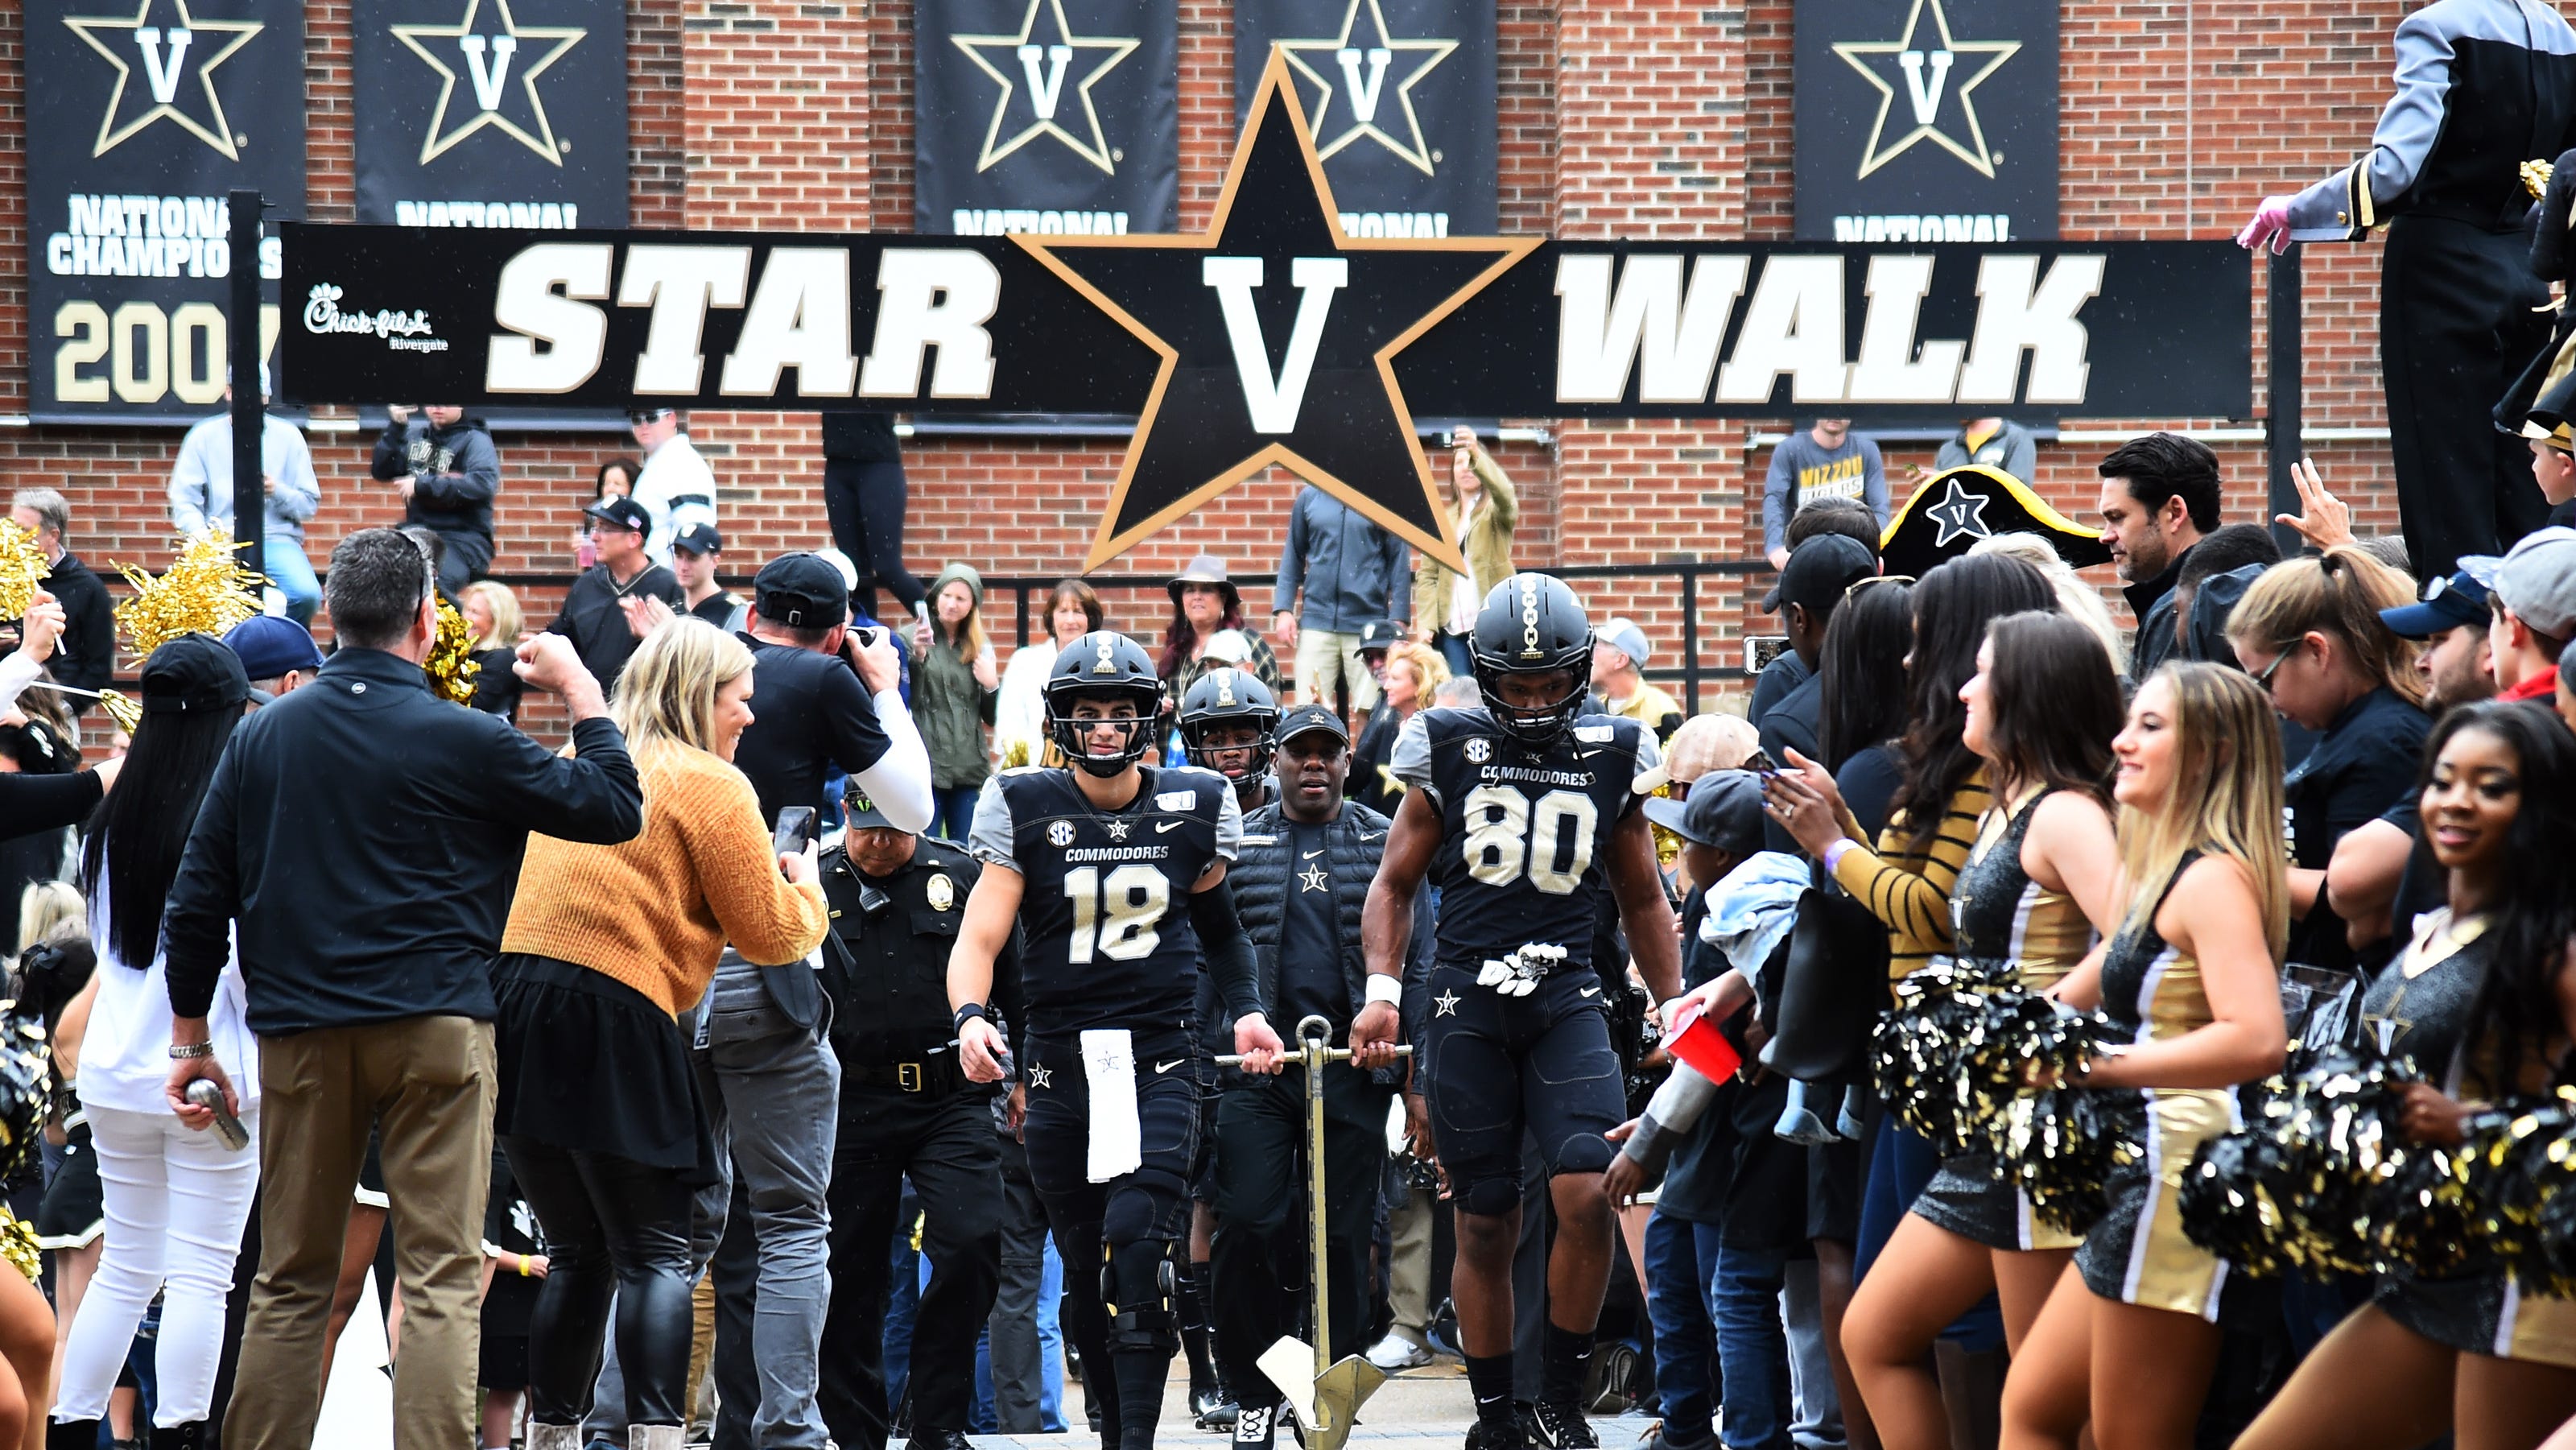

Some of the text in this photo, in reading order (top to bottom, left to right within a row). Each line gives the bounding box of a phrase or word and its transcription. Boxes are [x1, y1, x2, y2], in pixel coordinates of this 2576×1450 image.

[134, 27, 192, 103] V
[460, 35, 517, 110] V
[1017, 45, 1073, 119] V
[1337, 48, 1393, 122] V
[1899, 51, 1954, 124] V
[68, 194, 231, 238] NATIONA
[1338, 213, 1449, 238] IONA
[47, 233, 283, 279] CHAMPIOS
[389, 337, 448, 353] Rivergate
[485, 243, 2107, 433] STAR V WALK
[1800, 454, 1864, 488] MIZZOU
[1949, 503, 1967, 526] V
[1465, 739, 1491, 762] SEC
[1480, 765, 1587, 787] COMMODORES
[1048, 820, 1075, 846] SEC
[1065, 845, 1170, 862] COMMODORES
[1463, 784, 1599, 896] 80
[1064, 863, 1170, 965] 18
